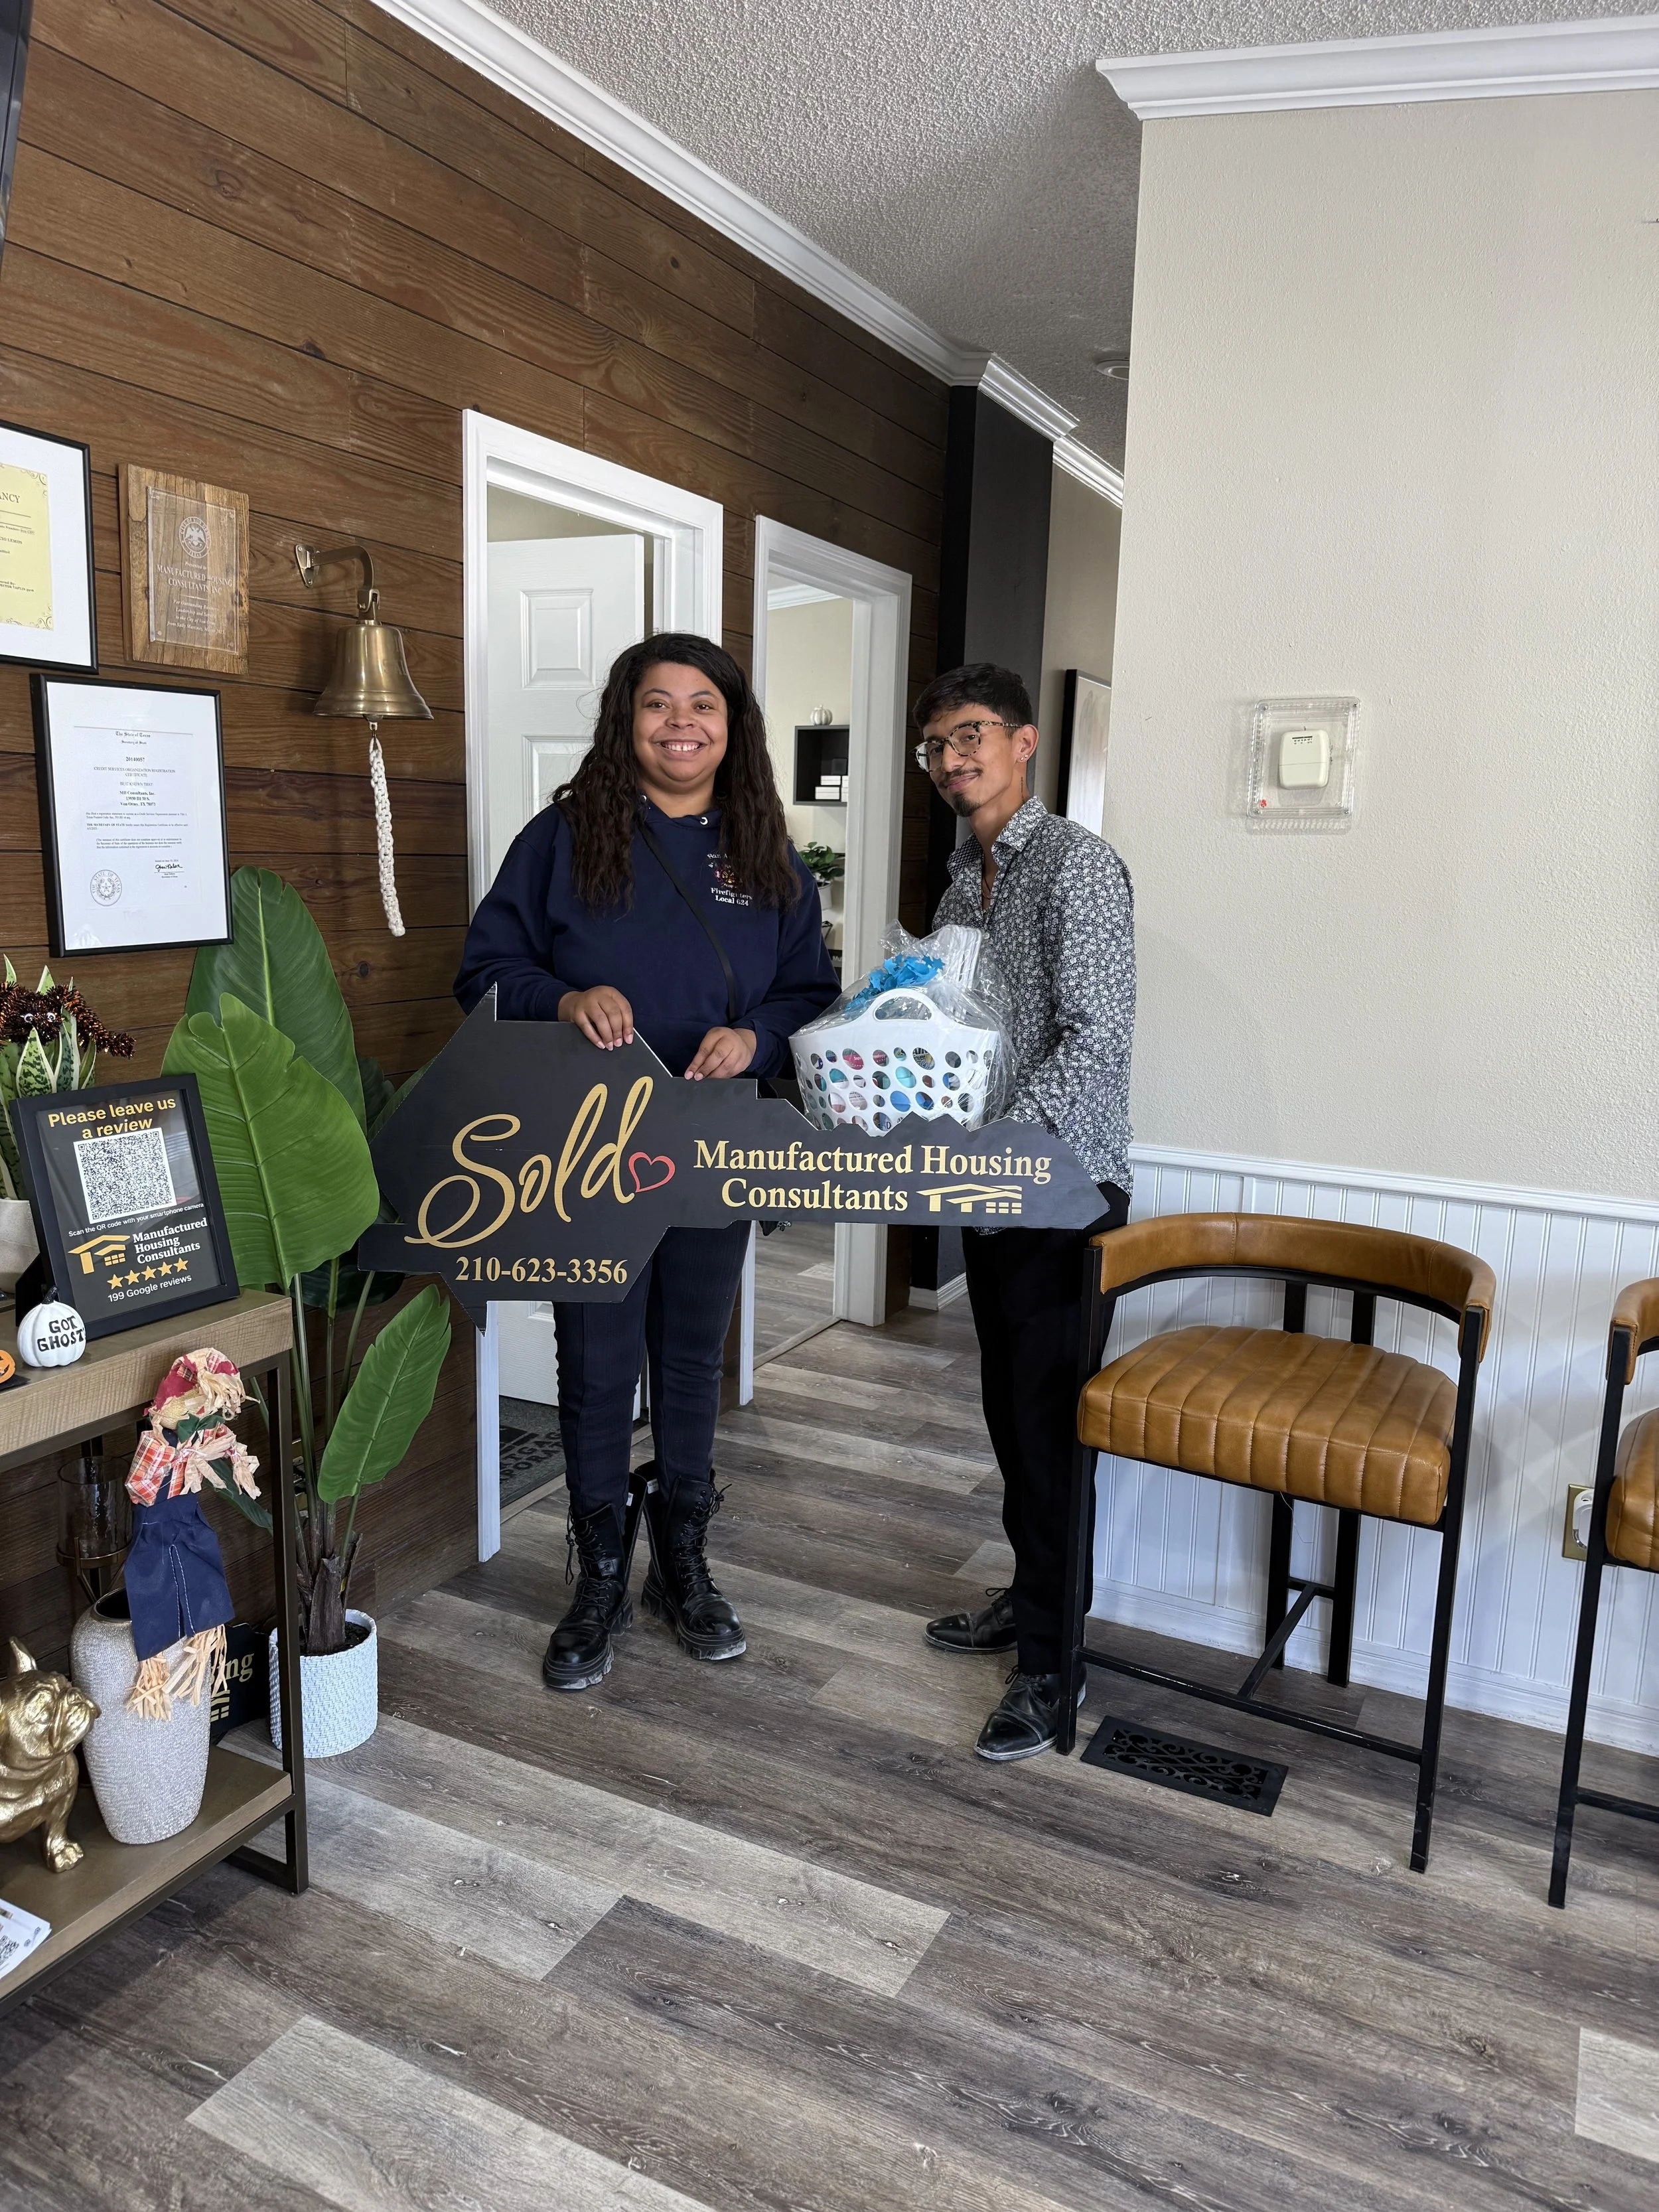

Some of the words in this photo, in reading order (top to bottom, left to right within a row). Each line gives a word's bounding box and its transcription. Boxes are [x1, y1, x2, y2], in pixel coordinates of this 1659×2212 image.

[157, 564, 206, 581] MANUFACTURED
[206, 575, 232, 587] HOUSING
[715, 895, 735, 904] Local
[48, 1109, 106, 1127] Please
[109, 1101, 153, 1118] leave
[157, 1098, 176, 1110] us
[82, 1128, 92, 1139] a
[97, 1118, 152, 1136] review
[404, 1076, 654, 1248] Sold
[693, 1140, 914, 1174] Manufactured
[920, 1145, 1052, 1185] Housing
[721, 1177, 908, 1212] Consultants
[68, 1228, 84, 1237] Scan
[136, 1214, 149, 1222] your
[150, 1207, 183, 1219] smartphone
[184, 1203, 204, 1211] camera
[133, 1218, 208, 1243] Manufactured
[134, 1237, 180, 1254] Housing
[137, 1242, 200, 1264] Consultants
[455, 1256, 628, 1284] 210-623-3356
[108, 1291, 125, 1302] 199
[126, 1283, 158, 1298] Google
[160, 1275, 192, 1289] reviews
[48, 1315, 78, 1333] GOT
[37, 1327, 85, 1352] GHOST
[210, 1653, 255, 1682] ng
